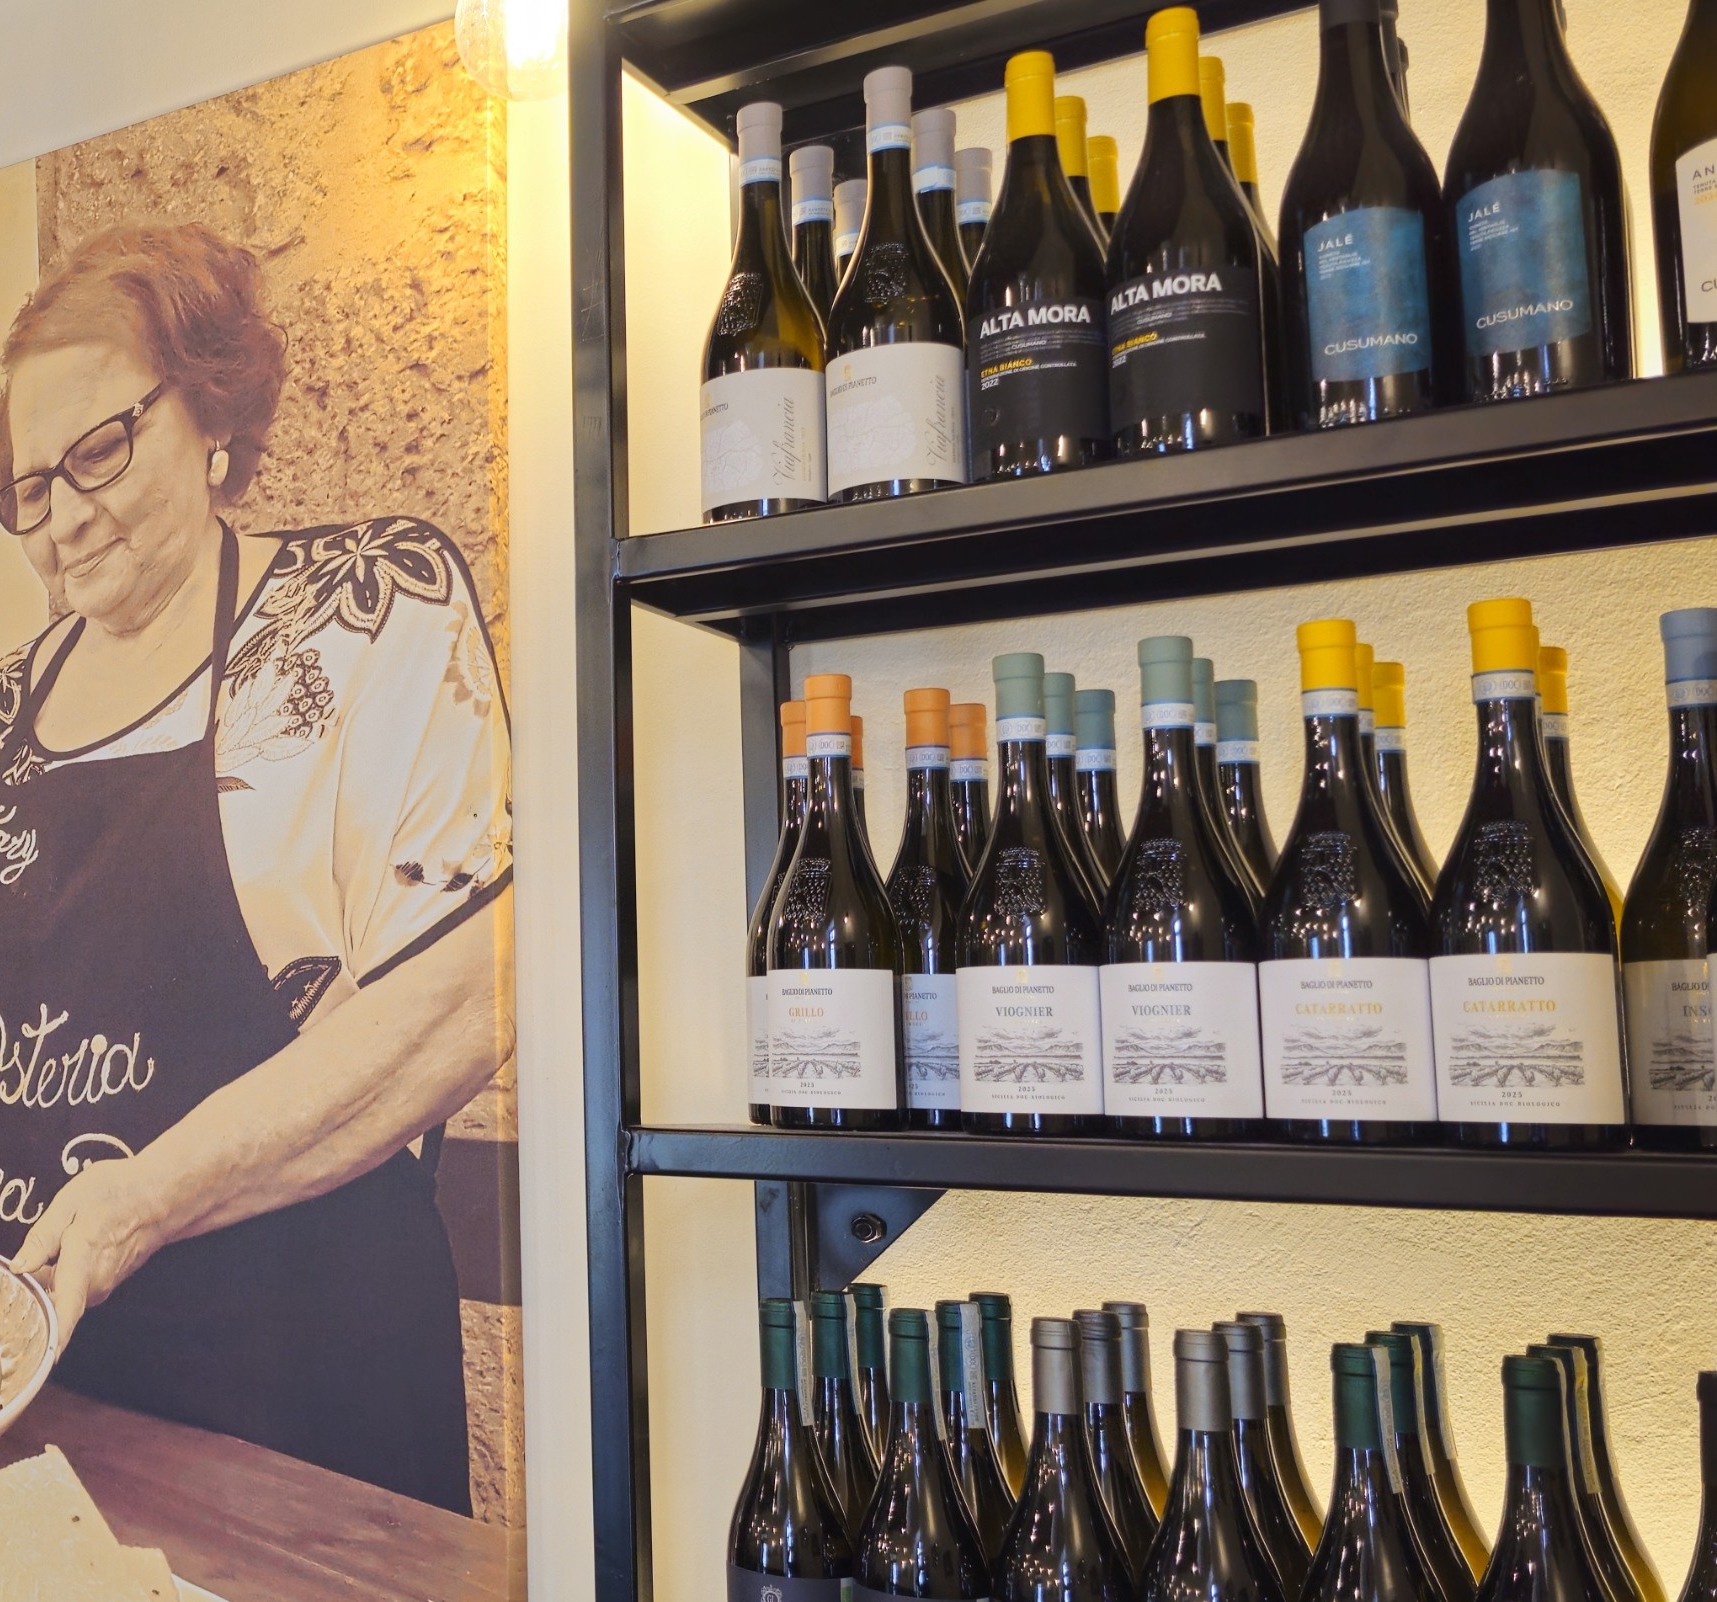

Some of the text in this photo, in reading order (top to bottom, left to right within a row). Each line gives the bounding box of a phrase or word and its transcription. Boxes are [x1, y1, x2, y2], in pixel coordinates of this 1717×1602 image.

[1318, 233, 1353, 252] JALÉ
[1111, 272, 1222, 315] ALTA MORA
[1476, 300, 1573, 329] CUSUMANO
[980, 310, 1024, 339] ALTA
[1027, 304, 1091, 326] MORA
[1011, 340, 1047, 350] CUSUMANO
[1324, 333, 1418, 356] CUSUMANO
[981, 358, 1033, 378] ETNA BIANCO
[981, 377, 999, 390] 2022
[1300, 980, 1373, 990] BAGLIO DI PIANETTO
[1468, 976, 1545, 986] BAGLIO DI PIANETTO
[1672, 982, 1700, 991] BAGLIO
[805, 988, 833, 996] PIANETTO
[992, 986, 1054, 994] BAGLIO DI PIANETTO
[1128, 983, 1193, 993] BAGLIO DI PIANETTO
[908, 992, 938, 1000] PIANETTO
[995, 1006, 1054, 1017] VIOGNIER
[1132, 1004, 1192, 1016] VIOGNIER
[1295, 1002, 1383, 1015] CATARRATTO
[1463, 999, 1556, 1013] CATARRATTO
[788, 1007, 824, 1017] GRILLO
